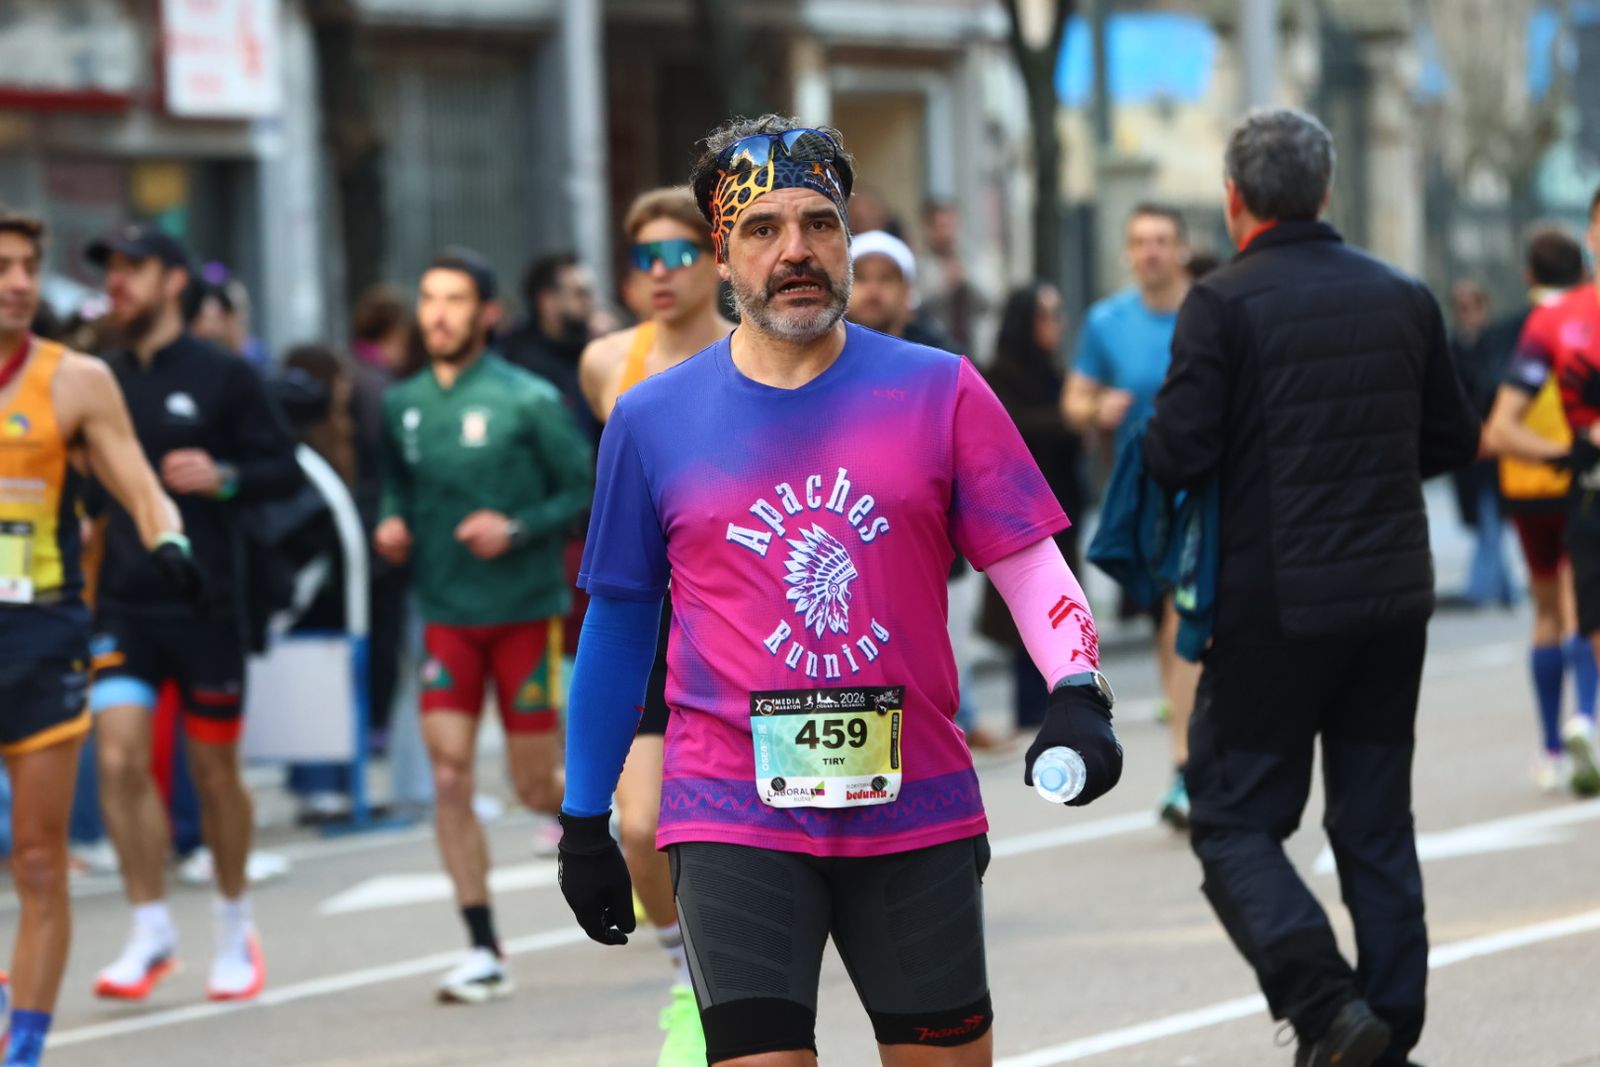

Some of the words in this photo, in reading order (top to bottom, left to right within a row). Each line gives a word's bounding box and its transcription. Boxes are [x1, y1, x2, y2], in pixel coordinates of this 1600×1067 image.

[725, 466, 890, 557] Apaches
[763, 617, 890, 679] Running
[840, 692, 865, 704] 2026
[795, 718, 868, 750] 459
[822, 757, 846, 766] TIRY
[767, 788, 810, 798] LABORAL
